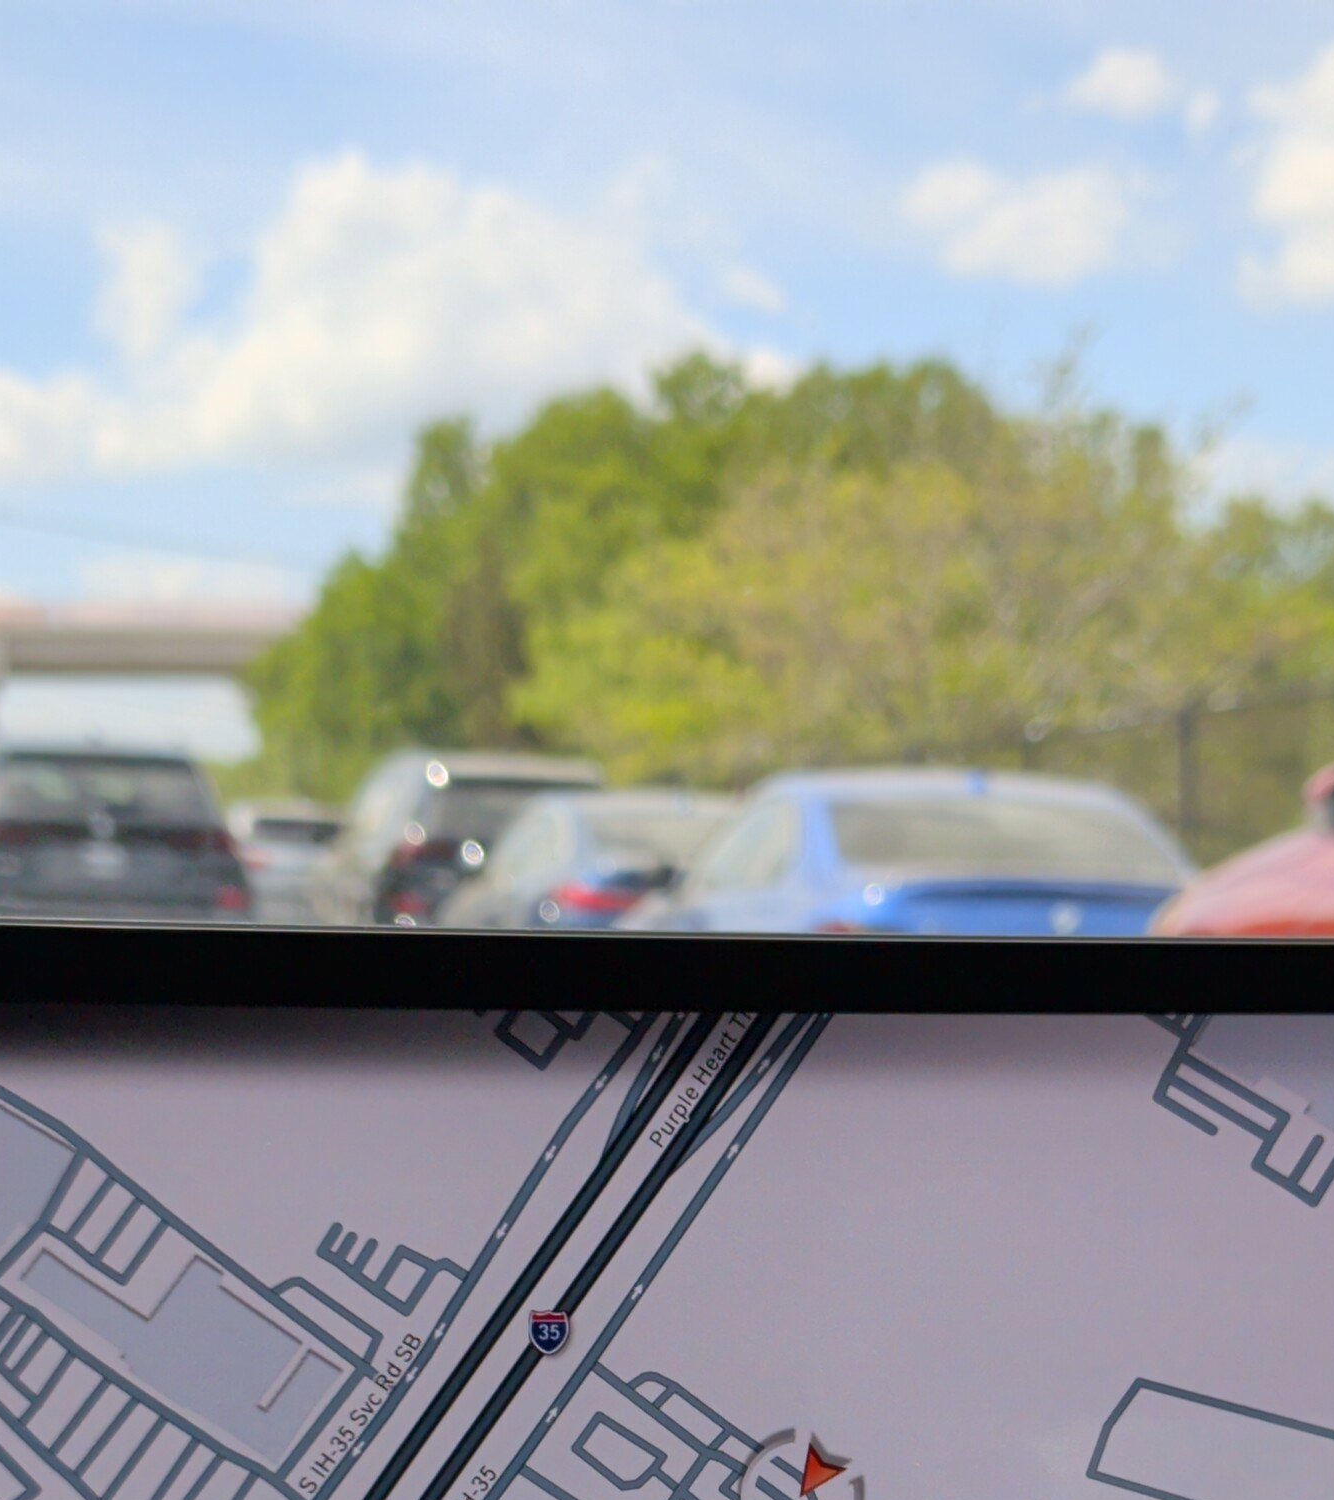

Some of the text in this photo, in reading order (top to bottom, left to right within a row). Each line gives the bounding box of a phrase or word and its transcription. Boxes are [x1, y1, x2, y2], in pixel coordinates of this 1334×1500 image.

[649, 1087, 699, 1148] Purple
[692, 1032, 737, 1085] Heart
[538, 1323, 561, 1341] 35
[299, 1333, 422, 1494] S IH-35 Svc Rd SB
